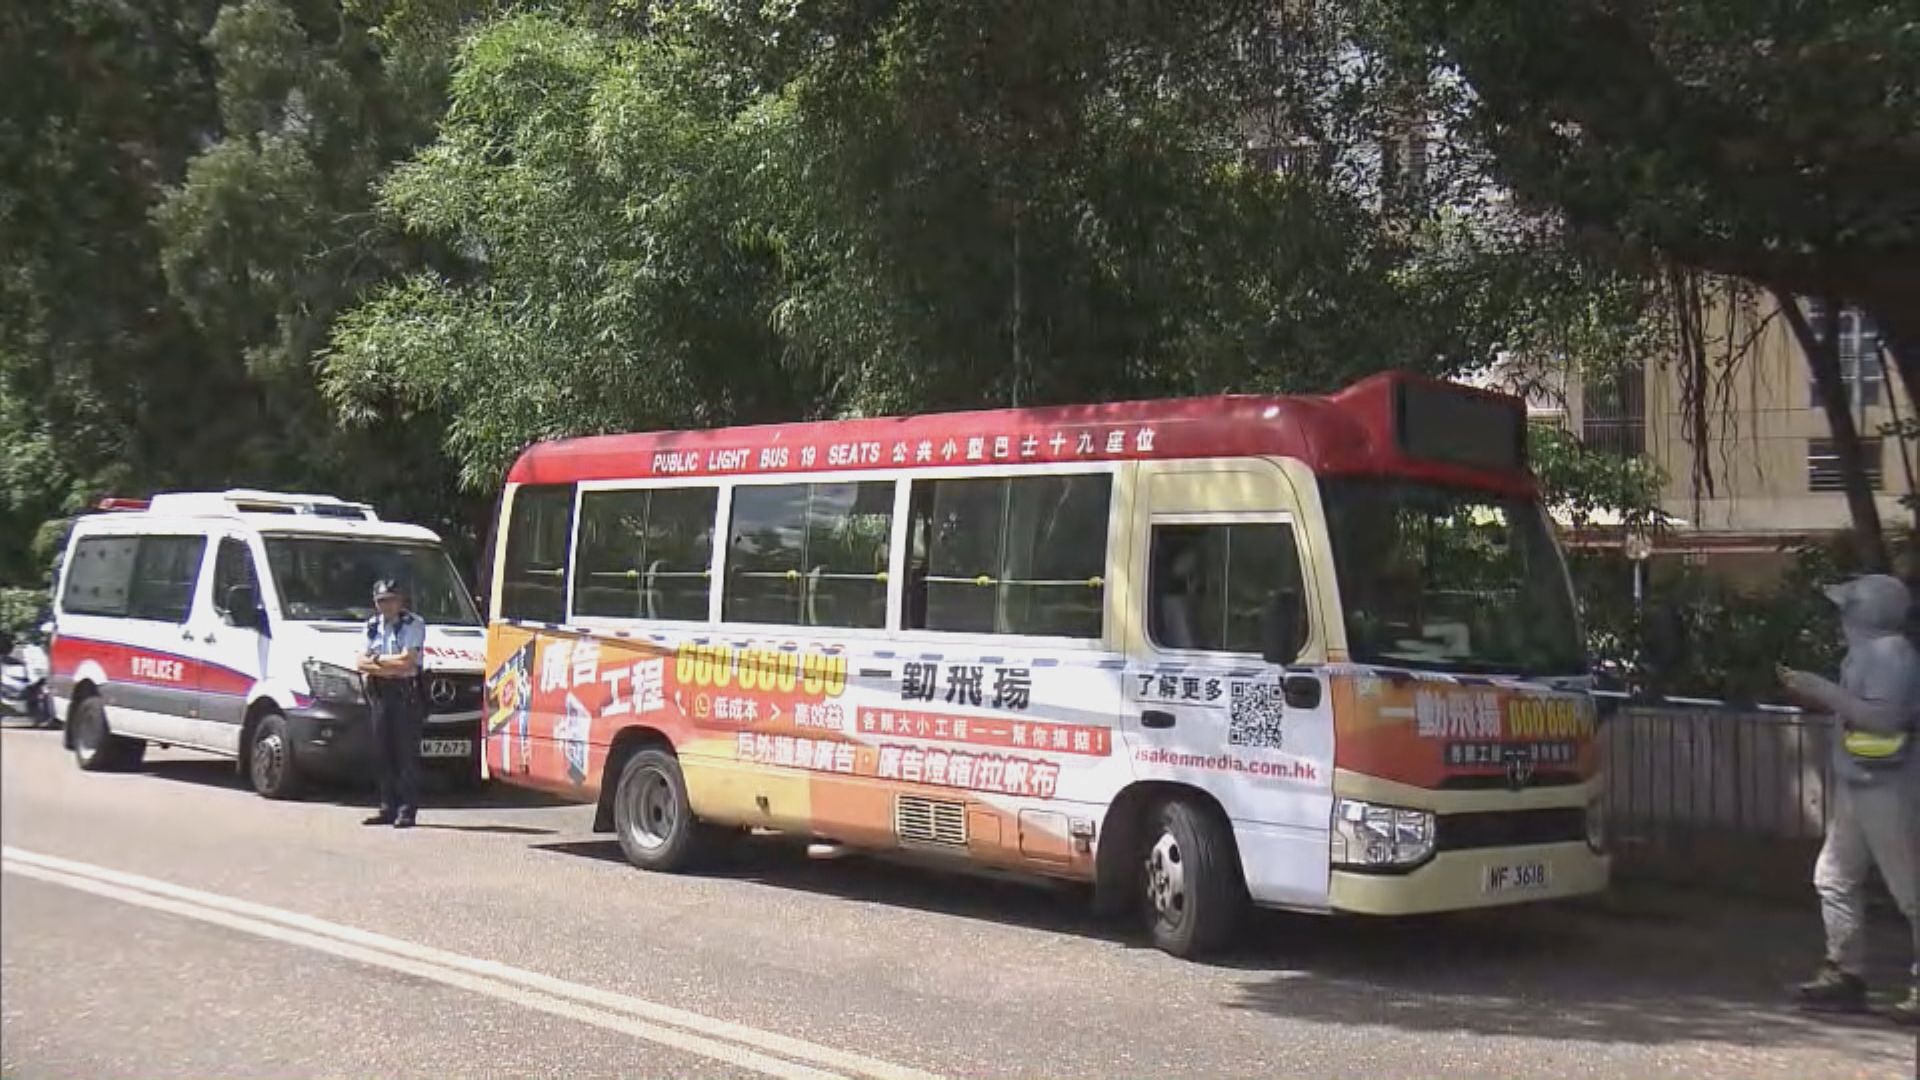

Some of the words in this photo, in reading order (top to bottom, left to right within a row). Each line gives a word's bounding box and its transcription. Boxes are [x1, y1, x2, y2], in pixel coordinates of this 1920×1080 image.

[652, 451, 699, 473] PUBLIC
[708, 448, 750, 471] LIGHT
[759, 447, 788, 468] BUS
[801, 446, 816, 467] 19
[828, 441, 881, 465] SEATS
[892, 427, 1155, 463] 公共小型巴士十九座位
[1138, 674, 1222, 701] 了解更多
[714, 696, 758, 721] 低成本
